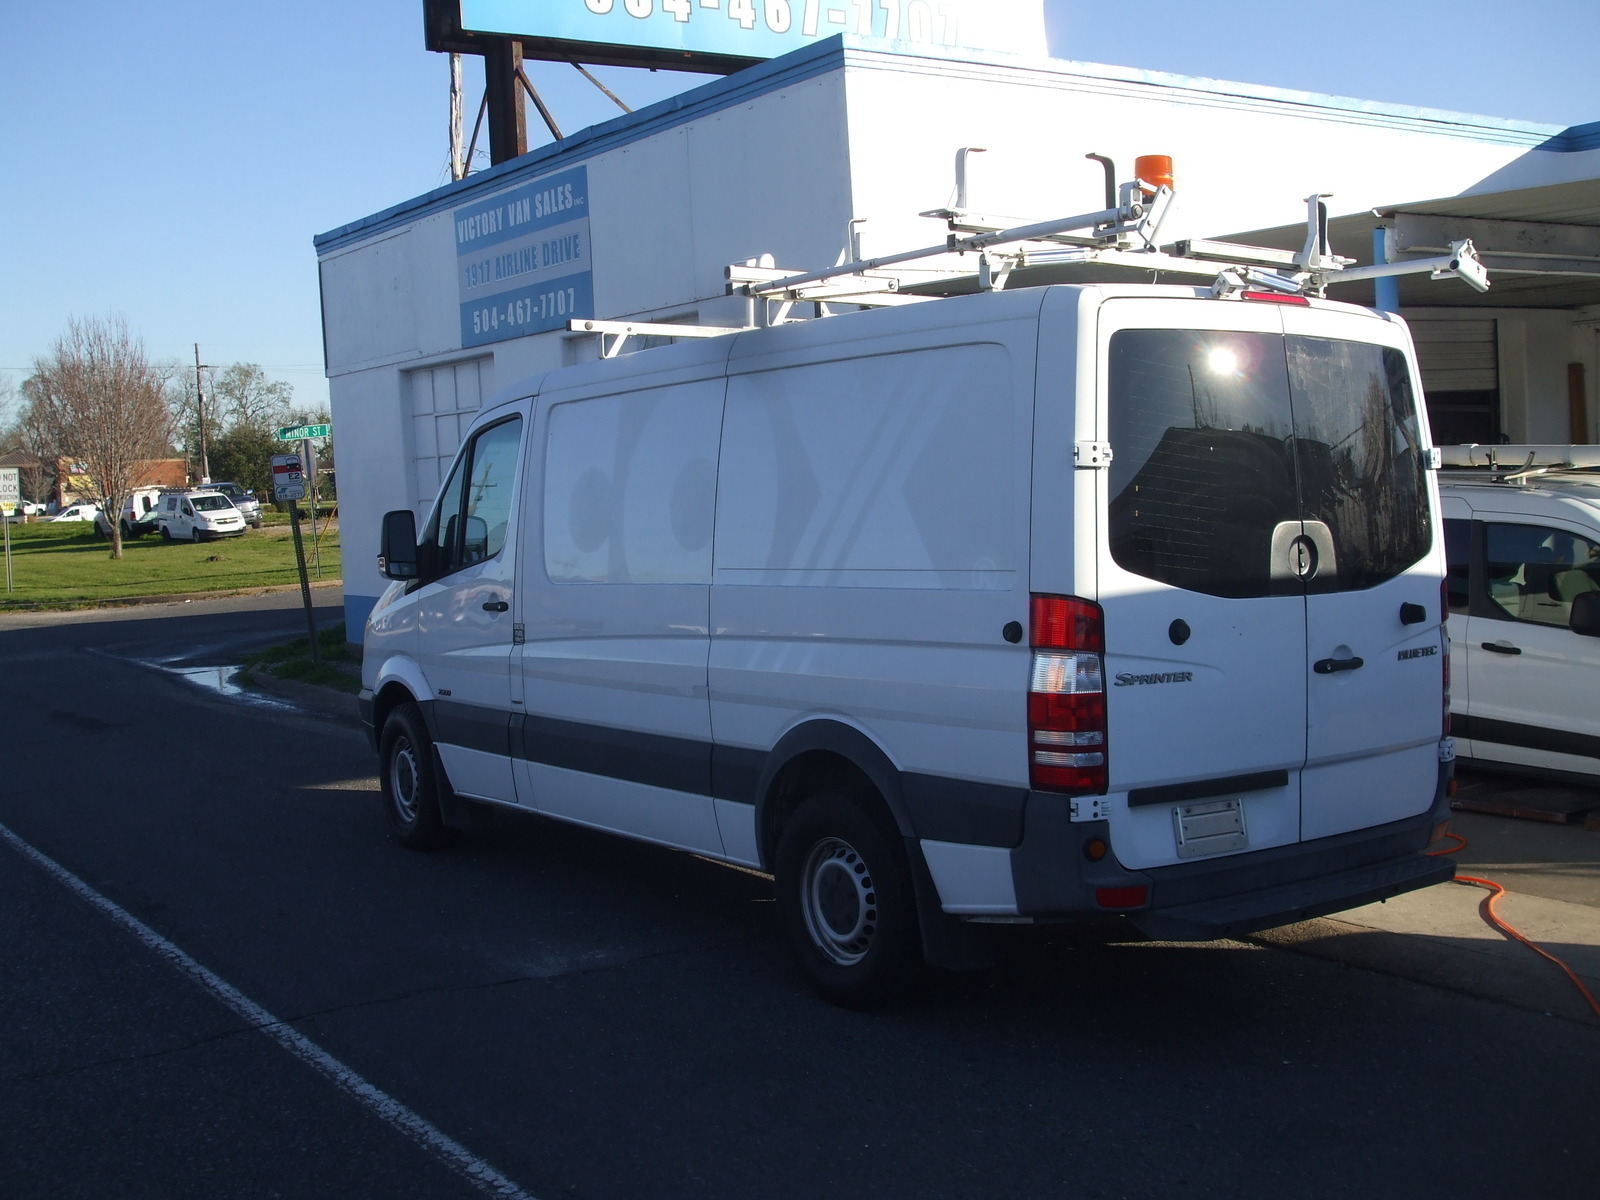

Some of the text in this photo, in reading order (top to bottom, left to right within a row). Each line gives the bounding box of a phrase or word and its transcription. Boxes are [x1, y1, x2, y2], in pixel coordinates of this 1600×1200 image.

[457, 207, 504, 243] VICTORY
[508, 197, 531, 227] VAN
[535, 183, 573, 218] SALES
[464, 233, 581, 289] 1917 AIRLINE DRIVE
[473, 288, 575, 335] 504-467-7707
[285, 426, 321, 438] MINOR ST
[3, 473, 17, 481] NOT
[288, 472, 300, 480] E2
[0, 484, 18, 493] OCK
